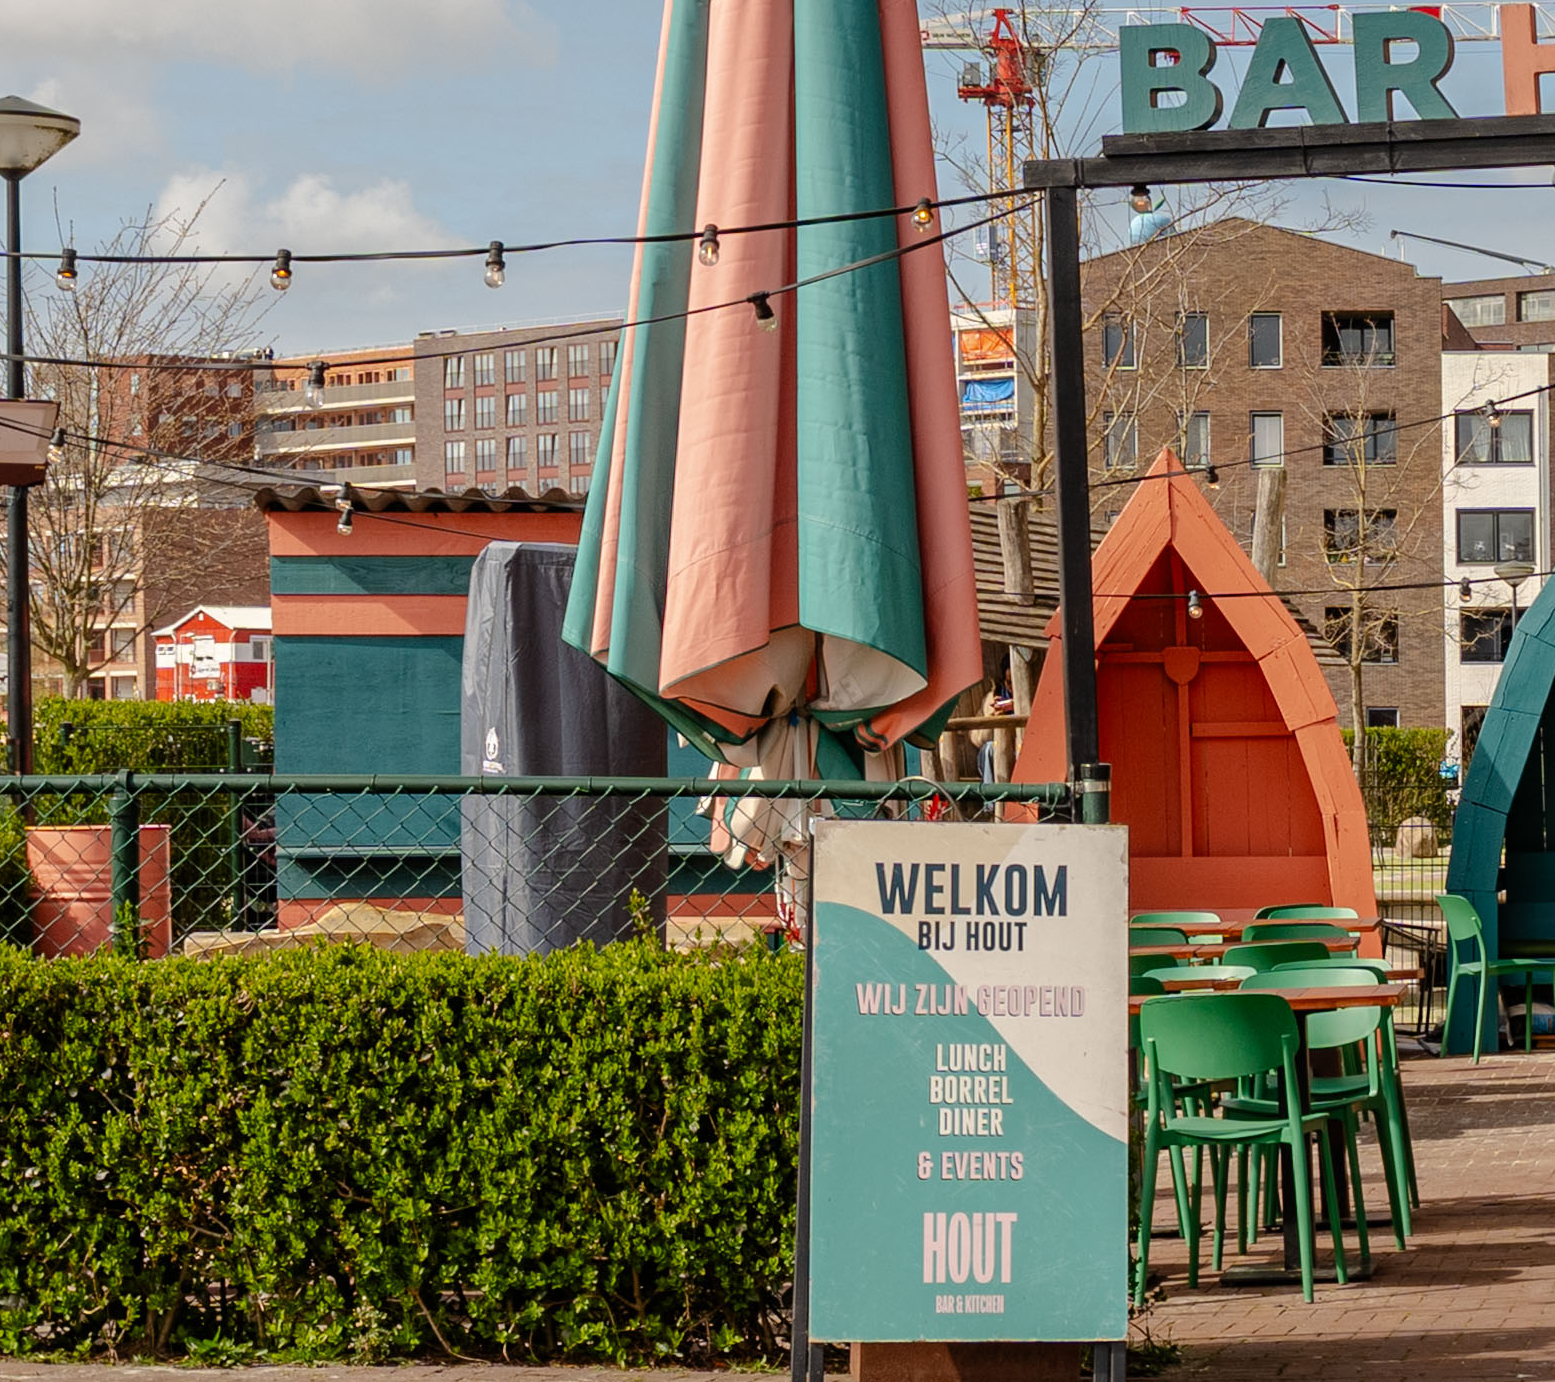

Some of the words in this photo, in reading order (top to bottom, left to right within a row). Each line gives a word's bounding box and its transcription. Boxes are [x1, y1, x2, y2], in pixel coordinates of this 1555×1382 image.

[1118, 11, 1458, 135] BAR
[875, 862, 1068, 917] WELKOM
[917, 921, 954, 951] BIJ
[965, 921, 1027, 952] HOUT
[855, 983, 907, 1017] WIJ
[915, 983, 970, 1017] ZIJN
[976, 984, 1086, 1018] GEOPEND
[935, 1043, 1007, 1073] LUNCH
[929, 1075, 1013, 1105] BORREL
[938, 1107, 1004, 1137] DINER
[916, 1151, 934, 1180] &
[940, 1151, 1024, 1180] EVENTS
[922, 1212, 1017, 1284] HOUT
[935, 1294, 955, 1314] BAR
[955, 1294, 964, 1314] &
[964, 1294, 1005, 1314] KITCHEN
